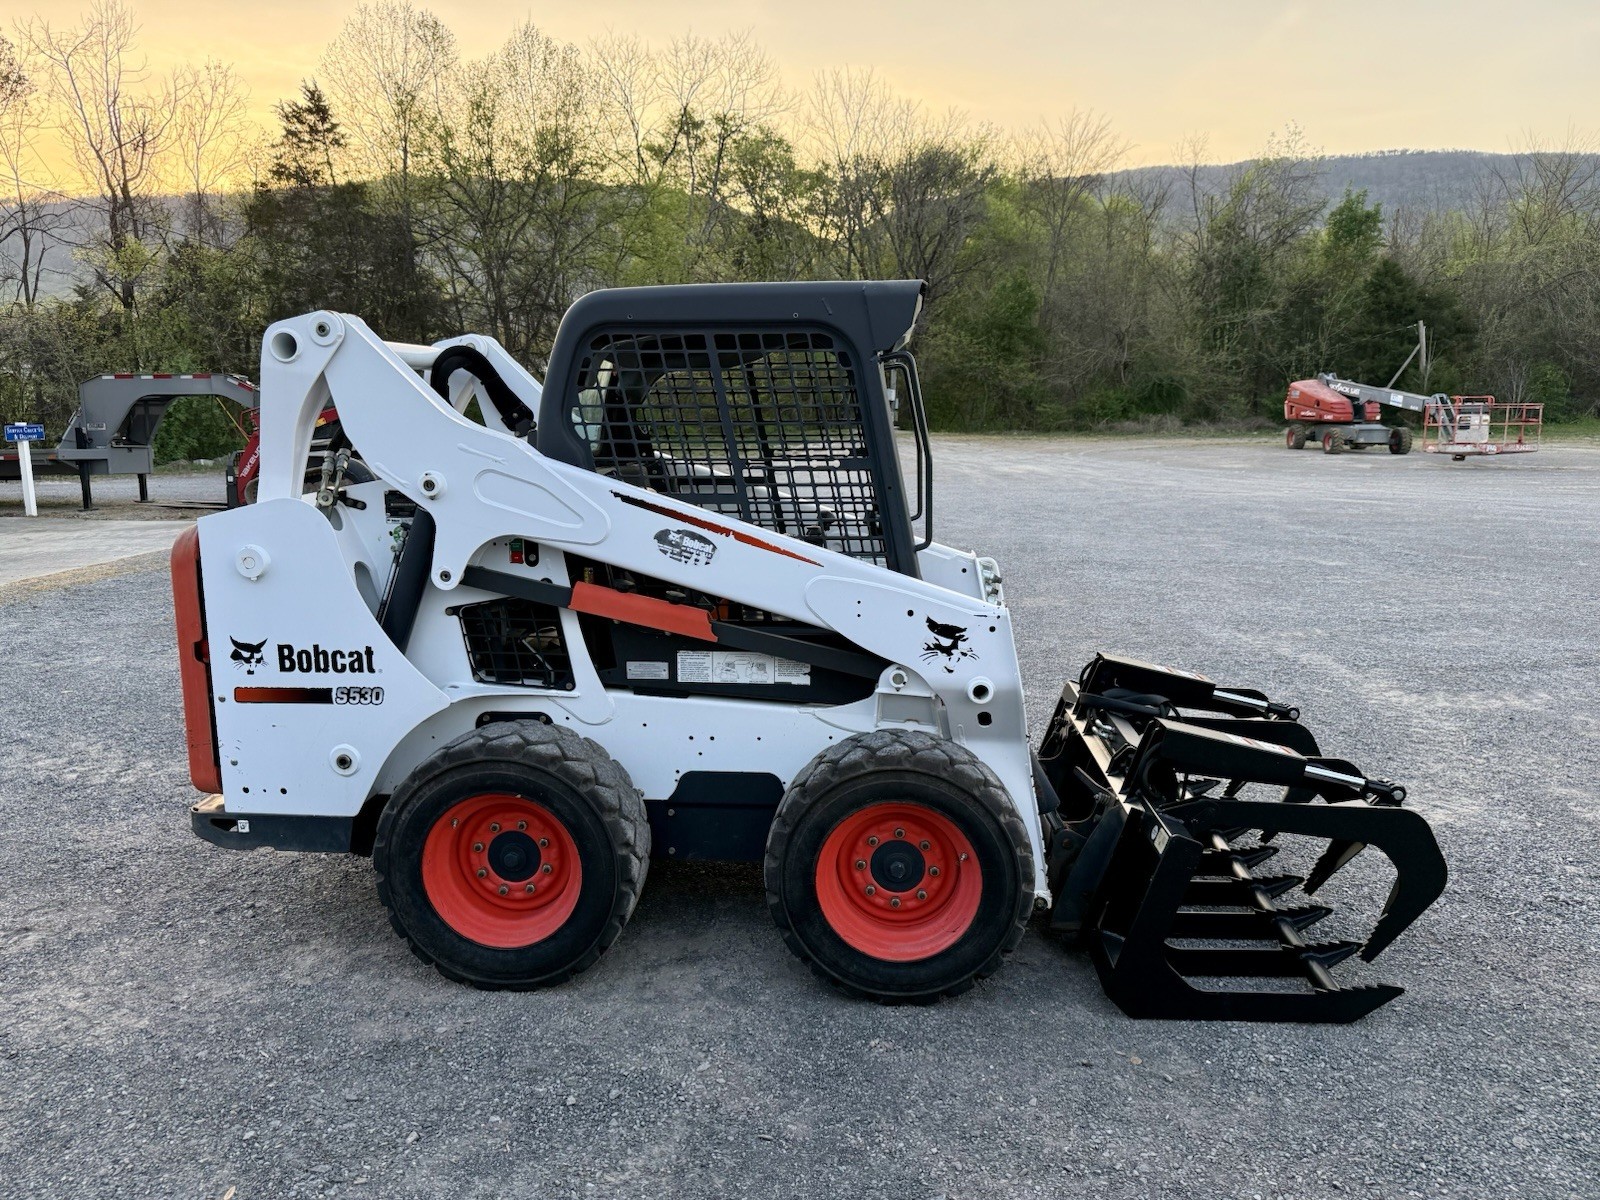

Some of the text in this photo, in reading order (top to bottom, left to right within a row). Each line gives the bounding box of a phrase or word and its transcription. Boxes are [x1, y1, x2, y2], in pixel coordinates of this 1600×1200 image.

[682, 536, 713, 553] Bobcat
[277, 644, 375, 673] Bobcat
[335, 687, 384, 705] S530
